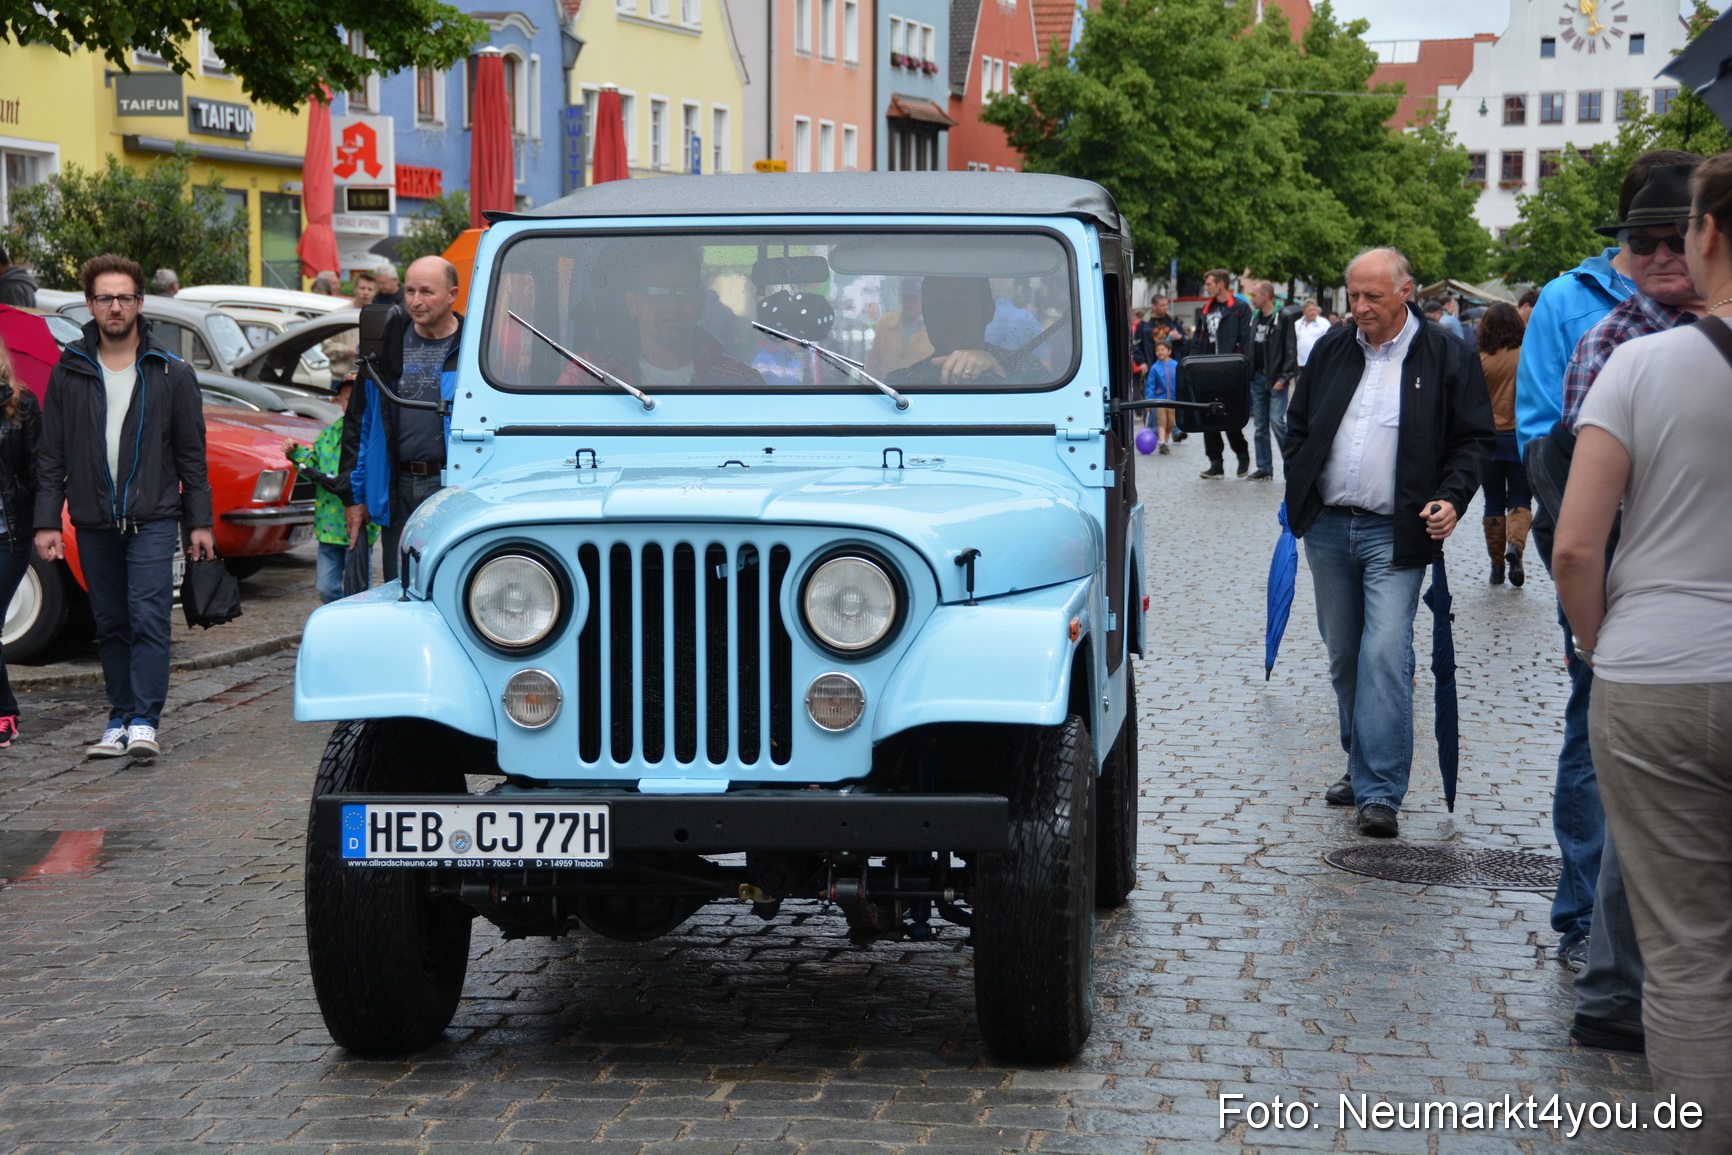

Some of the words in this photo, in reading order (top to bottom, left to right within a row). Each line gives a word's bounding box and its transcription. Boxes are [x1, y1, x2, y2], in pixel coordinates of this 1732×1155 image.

[120, 99, 179, 111] TAIFUN
[198, 102, 256, 133] TAIFUN
[566, 122, 583, 191] WITT
[396, 164, 443, 199] HEKE
[349, 838, 359, 849] D
[370, 811, 443, 852] HEB
[476, 811, 524, 852] CJ
[534, 812, 606, 853] 77H
[348, 858, 438, 868] www.allradscheune.de
[457, 858, 485, 868] 033731
[493, 858, 512, 868] 7065
[518, 858, 524, 868] 0
[536, 858, 543, 868] D
[550, 858, 573, 868] 14959
[575, 858, 604, 868] Trebbin
